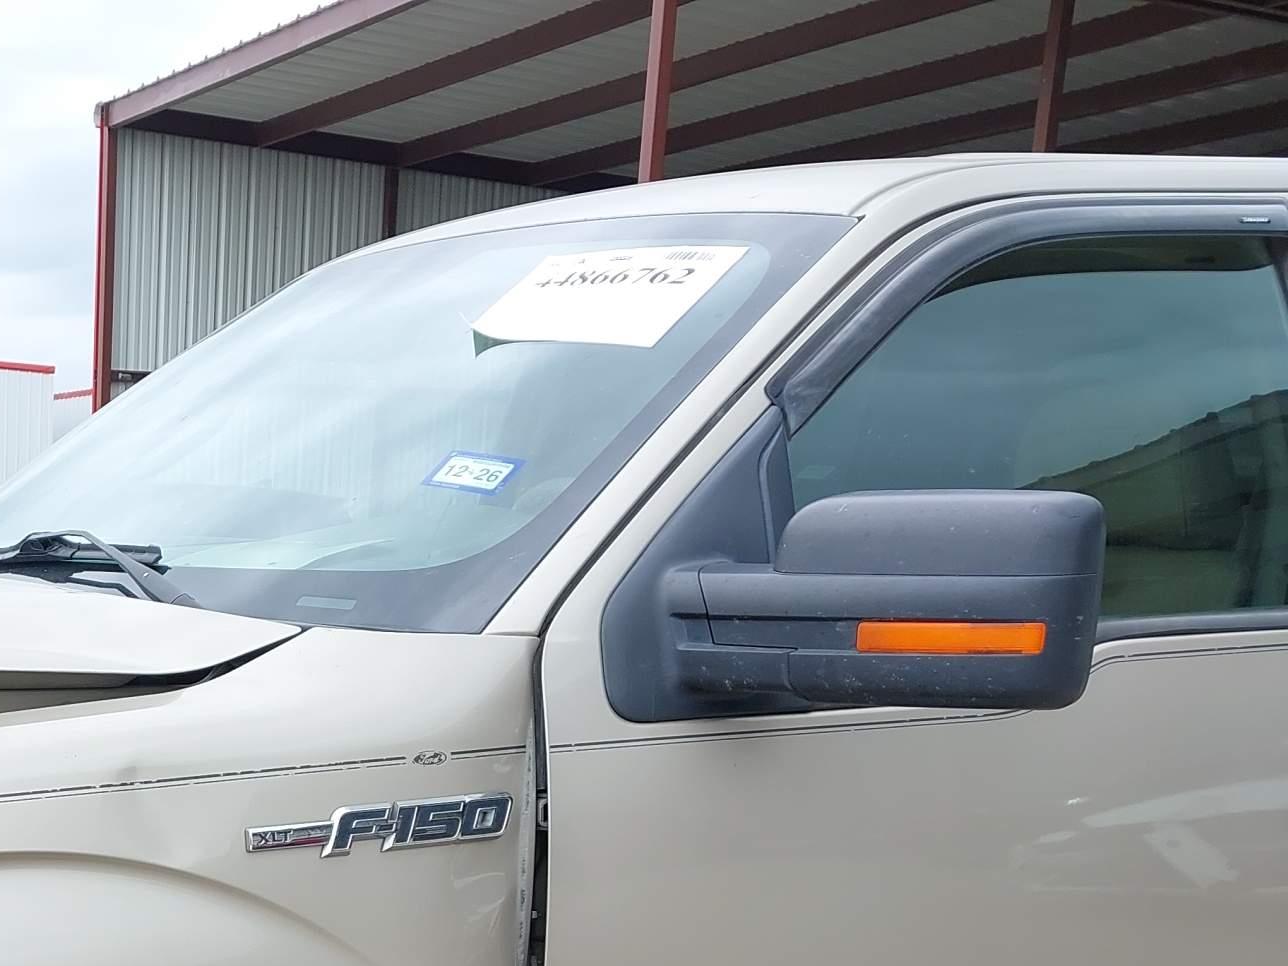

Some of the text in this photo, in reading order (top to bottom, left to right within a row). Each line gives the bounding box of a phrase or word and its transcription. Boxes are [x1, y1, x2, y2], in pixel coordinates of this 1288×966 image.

[443, 463, 504, 484] 12-26
[320, 791, 514, 858] F-150
[257, 829, 295, 846] XLT
